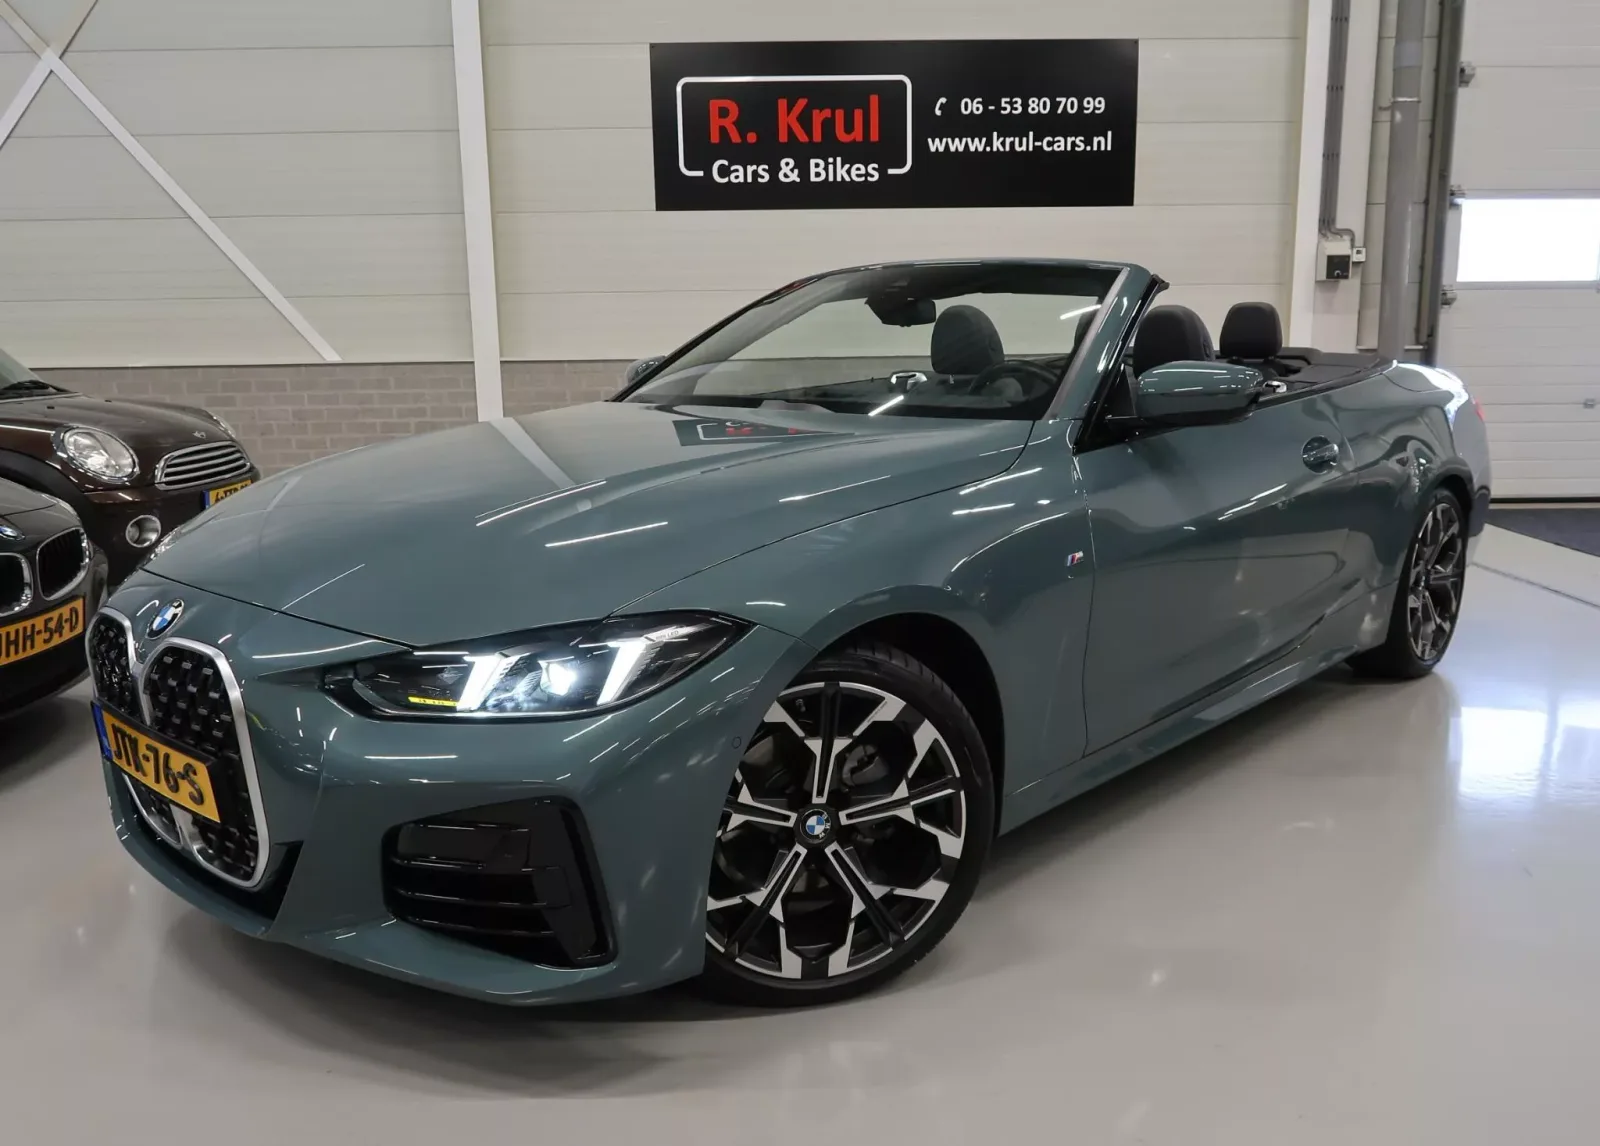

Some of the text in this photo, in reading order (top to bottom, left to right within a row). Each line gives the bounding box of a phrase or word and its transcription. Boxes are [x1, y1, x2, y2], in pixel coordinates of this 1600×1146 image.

[709, 94, 881, 144] R. Krul
[960, 97, 984, 115] 06
[1000, 97, 1023, 115] 53
[1027, 97, 1051, 115] 80
[1055, 97, 1079, 114] 70
[1083, 96, 1106, 114] 99
[927, 130, 1112, 153] www.krul-cars.nl
[711, 156, 880, 184] Cars & Bikes
[111, 722, 205, 805] JTK-76-S
